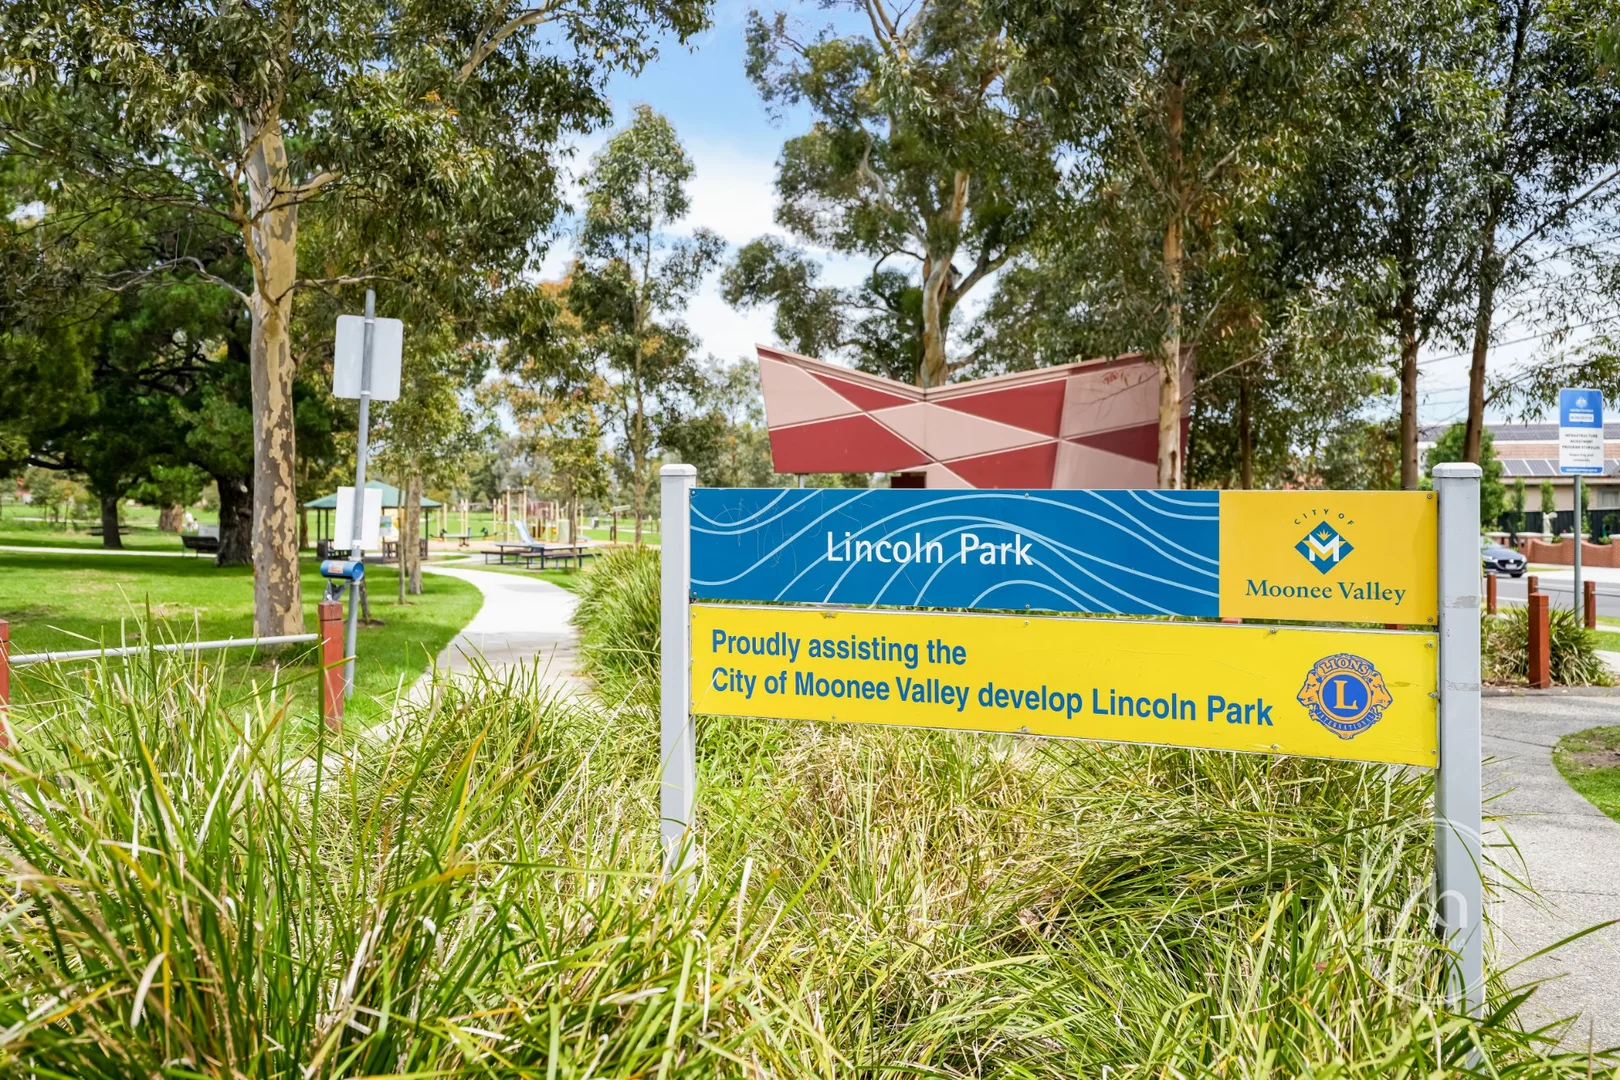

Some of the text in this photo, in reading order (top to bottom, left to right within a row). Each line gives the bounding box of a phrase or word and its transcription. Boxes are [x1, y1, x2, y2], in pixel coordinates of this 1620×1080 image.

[1293, 508, 1355, 526] CITY OF
[827, 531, 1034, 565] Lincoln Park
[1245, 578, 1407, 606] Moonee Valley
[712, 629, 967, 670] Proudly assisting the
[1319, 657, 1370, 675] LIONS
[712, 667, 1274, 726] City of Moonee Valley develop Lincoln Park
[1333, 679, 1359, 710] L
[1316, 710, 1376, 731] INTERNATIONAL
